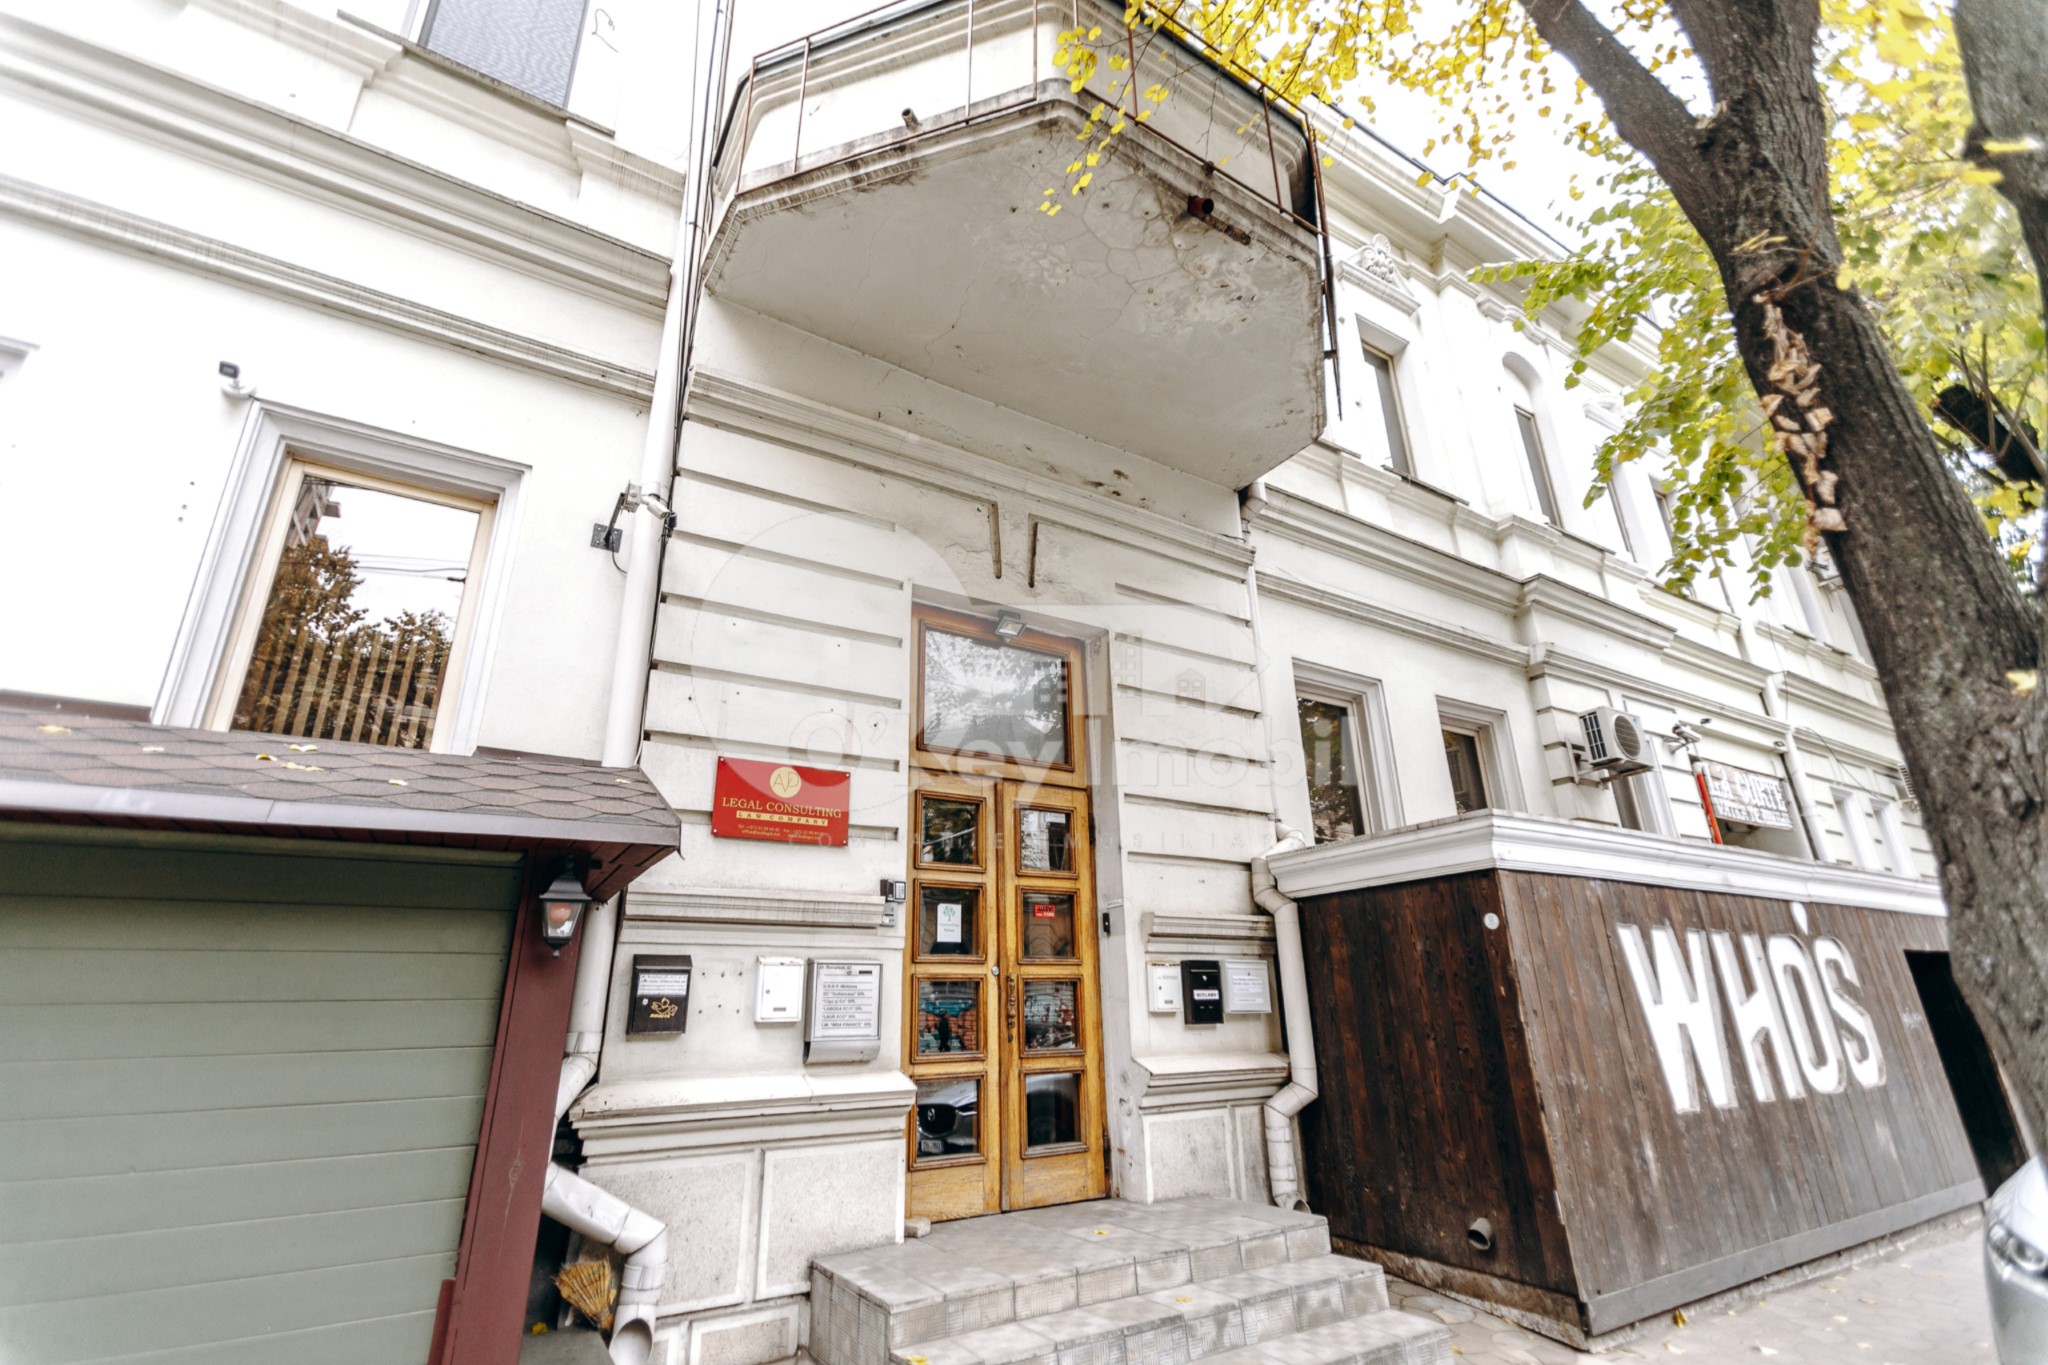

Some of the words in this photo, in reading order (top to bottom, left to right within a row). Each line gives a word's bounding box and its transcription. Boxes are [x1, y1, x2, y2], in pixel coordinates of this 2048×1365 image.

[722, 796, 762, 811] LEGAL
[766, 801, 842, 819] CONSULTING
[738, 812, 762, 820] LAW
[769, 814, 827, 826] COMPANY
[1616, 901, 1886, 1114] WHO'S
